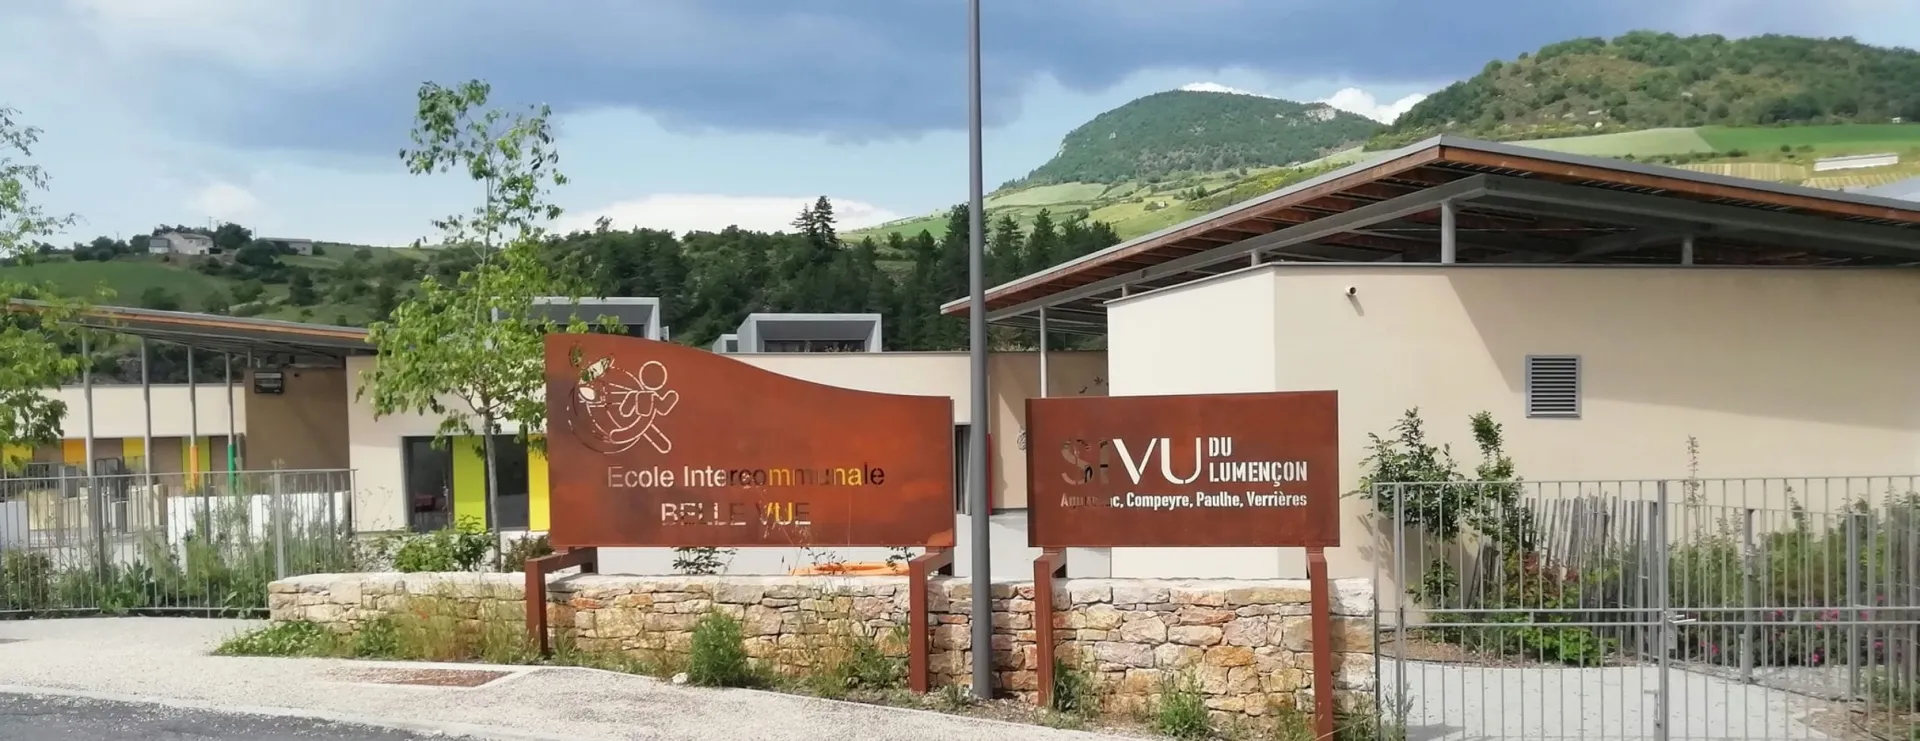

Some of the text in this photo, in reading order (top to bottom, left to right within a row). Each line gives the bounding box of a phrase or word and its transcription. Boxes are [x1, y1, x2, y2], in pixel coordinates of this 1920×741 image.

[1208, 436, 1232, 457] DU
[607, 462, 886, 488] Ecole Intercommunale
[1208, 461, 1308, 487] LUMENÇON
[1126, 491, 1194, 511] Compeyre,
[1196, 491, 1244, 508] Paulhe,
[1246, 490, 1308, 507] Verrières
[660, 502, 812, 526] BELLE VUE
